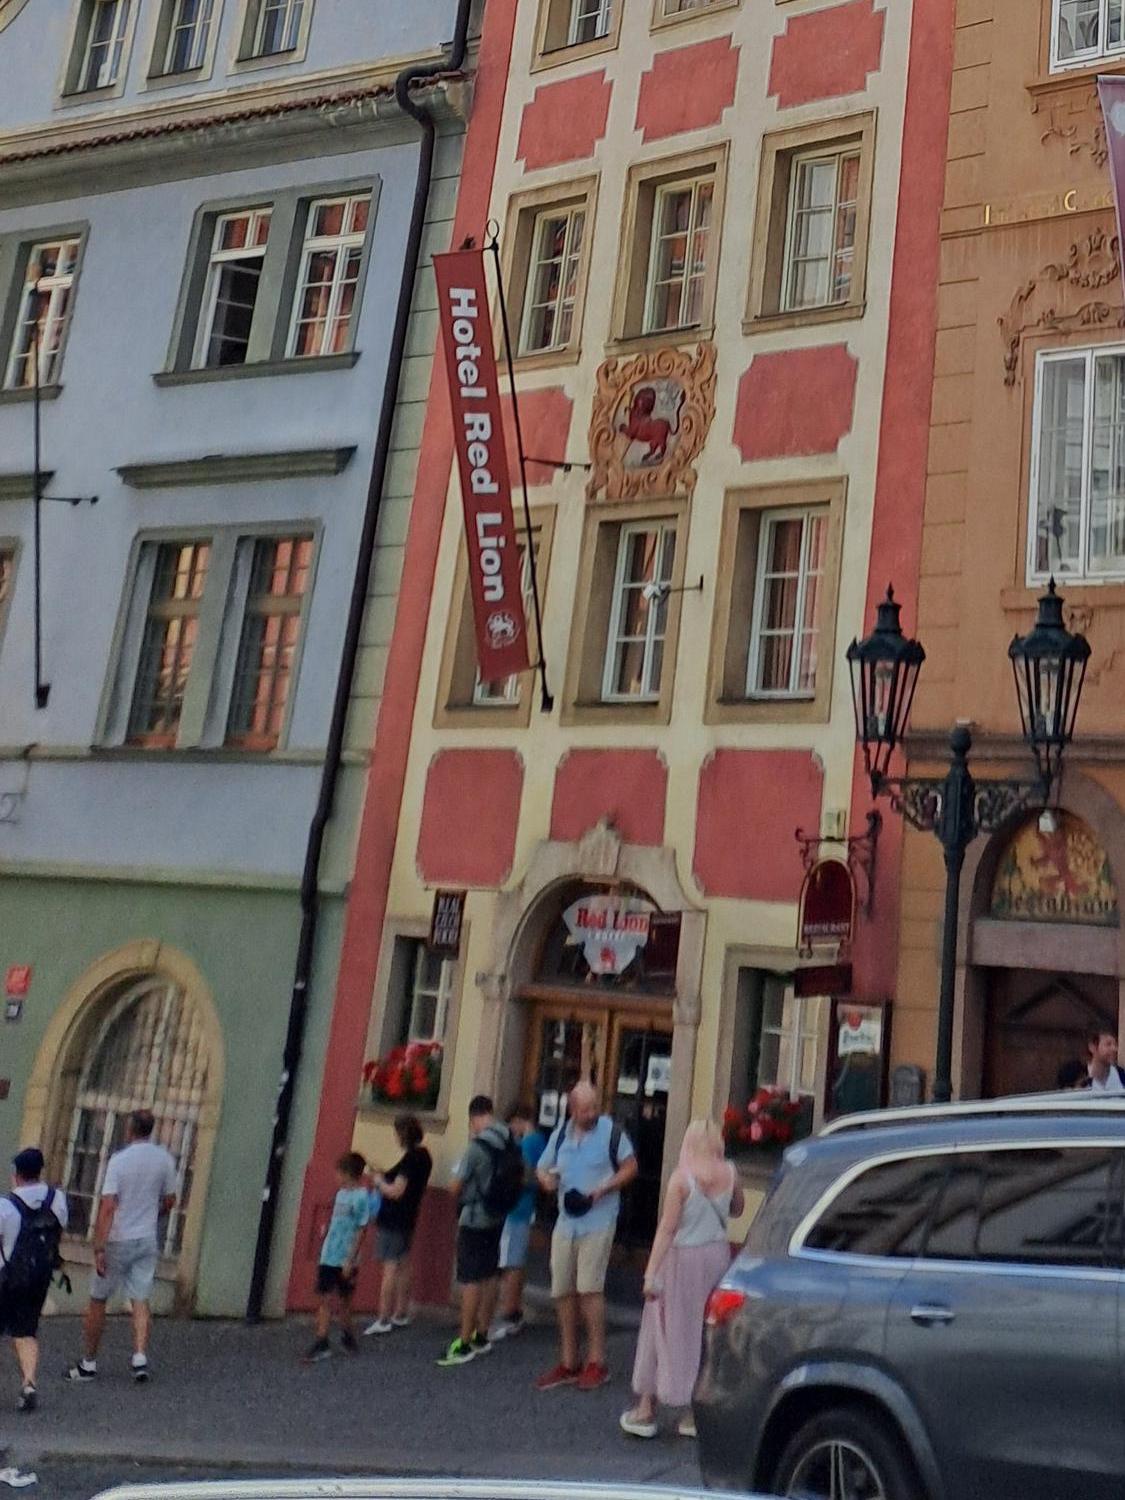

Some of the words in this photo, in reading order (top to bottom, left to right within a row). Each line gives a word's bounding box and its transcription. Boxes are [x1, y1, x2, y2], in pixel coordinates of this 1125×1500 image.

[449, 286, 488, 398] Hotel
[464, 412, 499, 495] Red
[475, 512, 506, 602] Lion
[575, 907, 608, 930] Red
[612, 909, 650, 933] Lion
